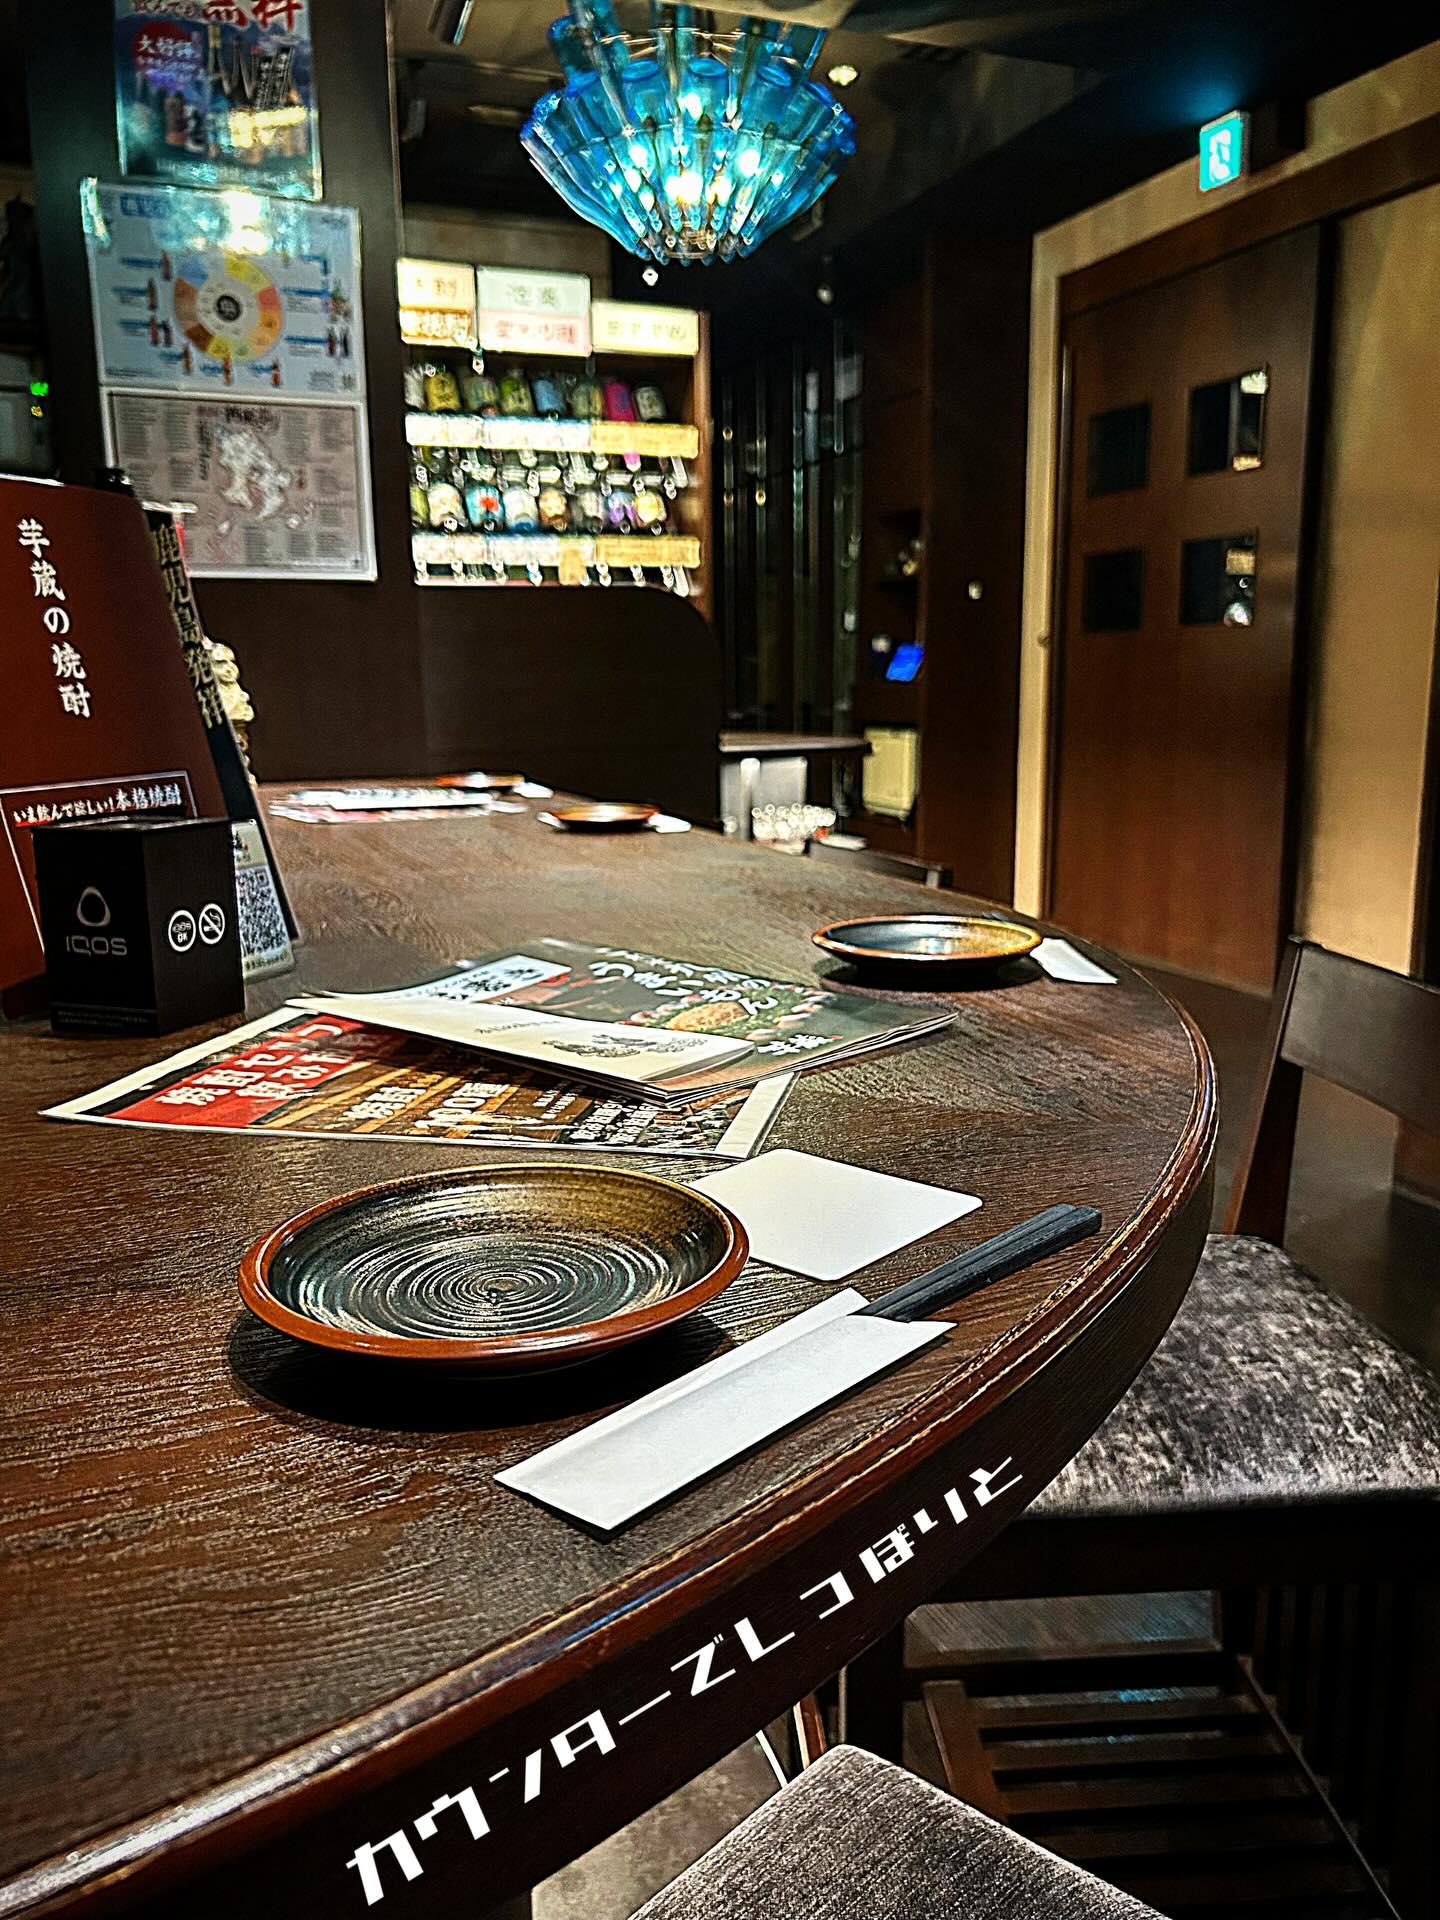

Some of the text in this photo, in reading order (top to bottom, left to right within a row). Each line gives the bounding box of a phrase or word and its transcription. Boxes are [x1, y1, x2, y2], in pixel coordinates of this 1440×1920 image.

[17, 517, 92, 719] 芋蔵の焼酎
[66, 935, 128, 958] IQOS
[588, 961, 780, 1016] うまいもん
[153, 1023, 343, 1107] 焼酎セルフ
[342, 1086, 429, 1119] 焼酎
